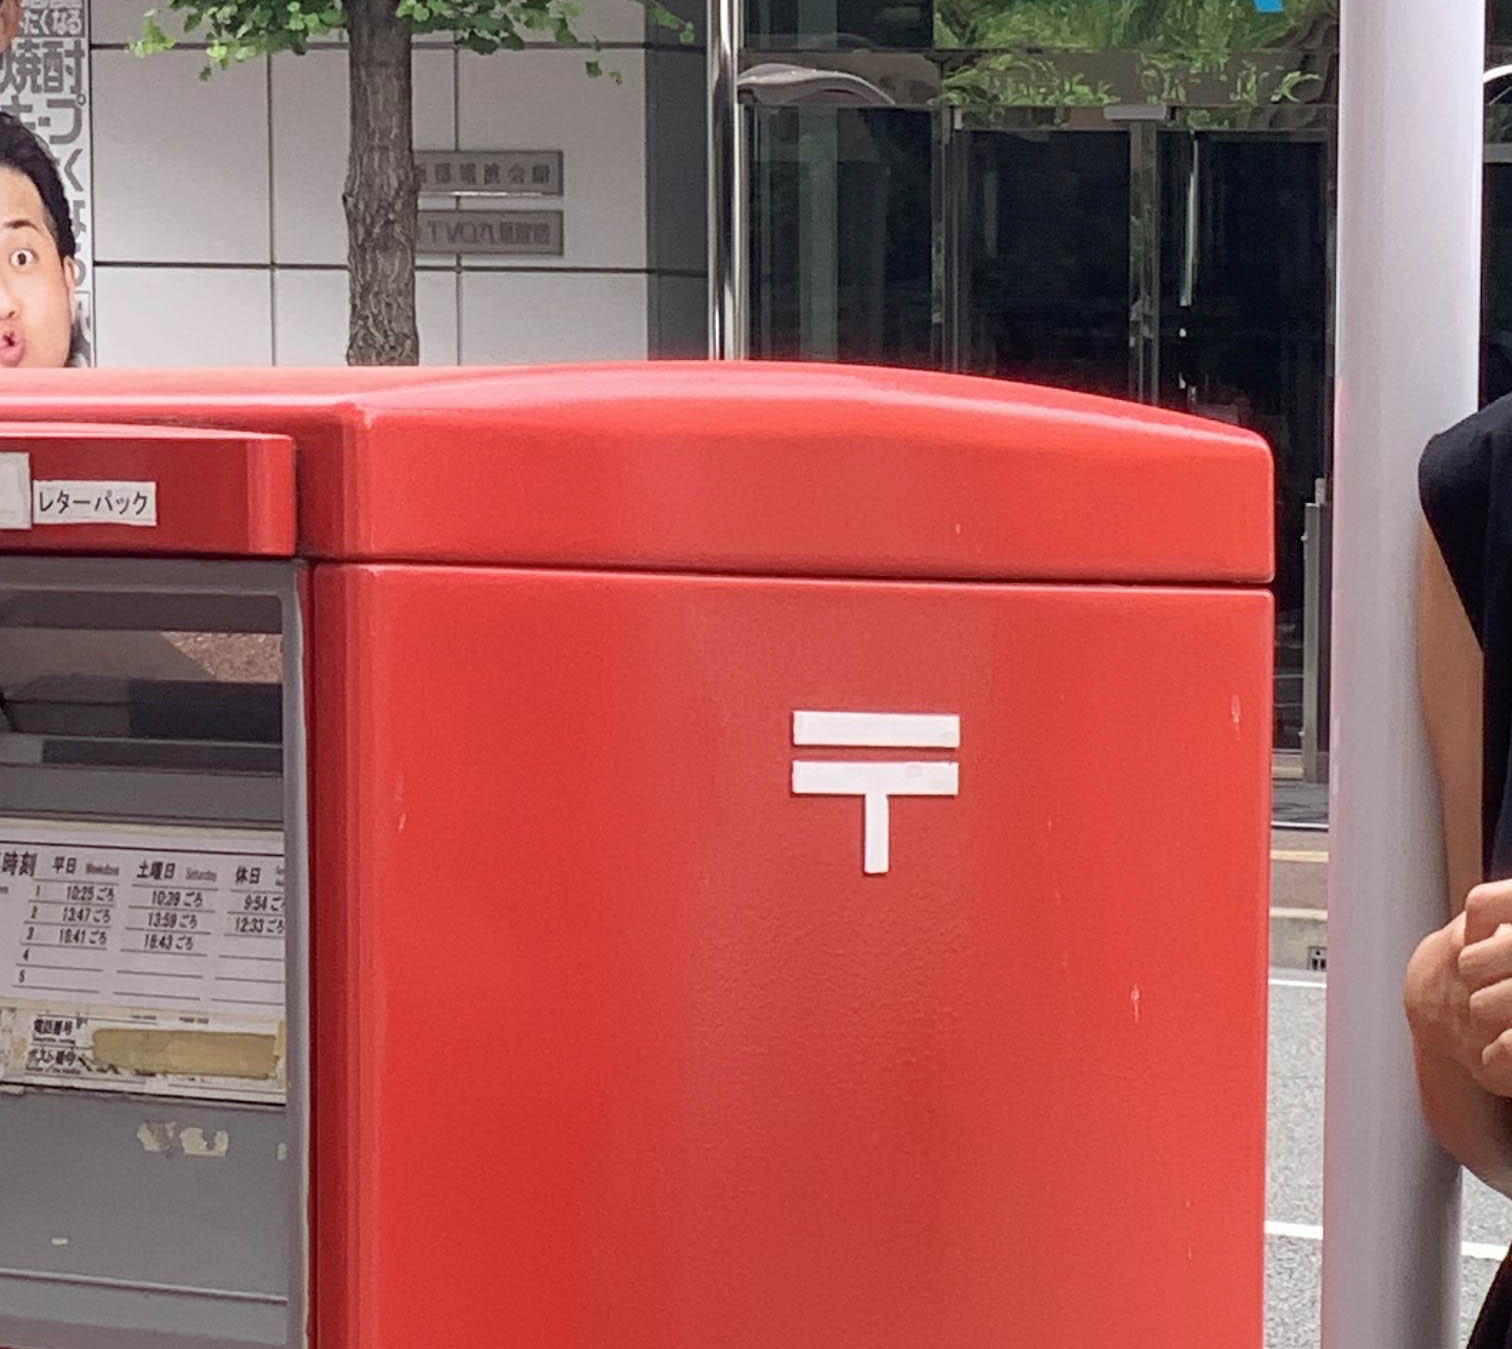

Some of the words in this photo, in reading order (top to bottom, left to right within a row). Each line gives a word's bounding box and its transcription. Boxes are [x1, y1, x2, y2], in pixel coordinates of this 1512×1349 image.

[39, 489, 148, 515] レターパック
[2, 852, 37, 877] 時刻
[52, 856, 77, 874] 平日
[136, 861, 176, 880] 土曜日
[235, 866, 261, 885] 休日
